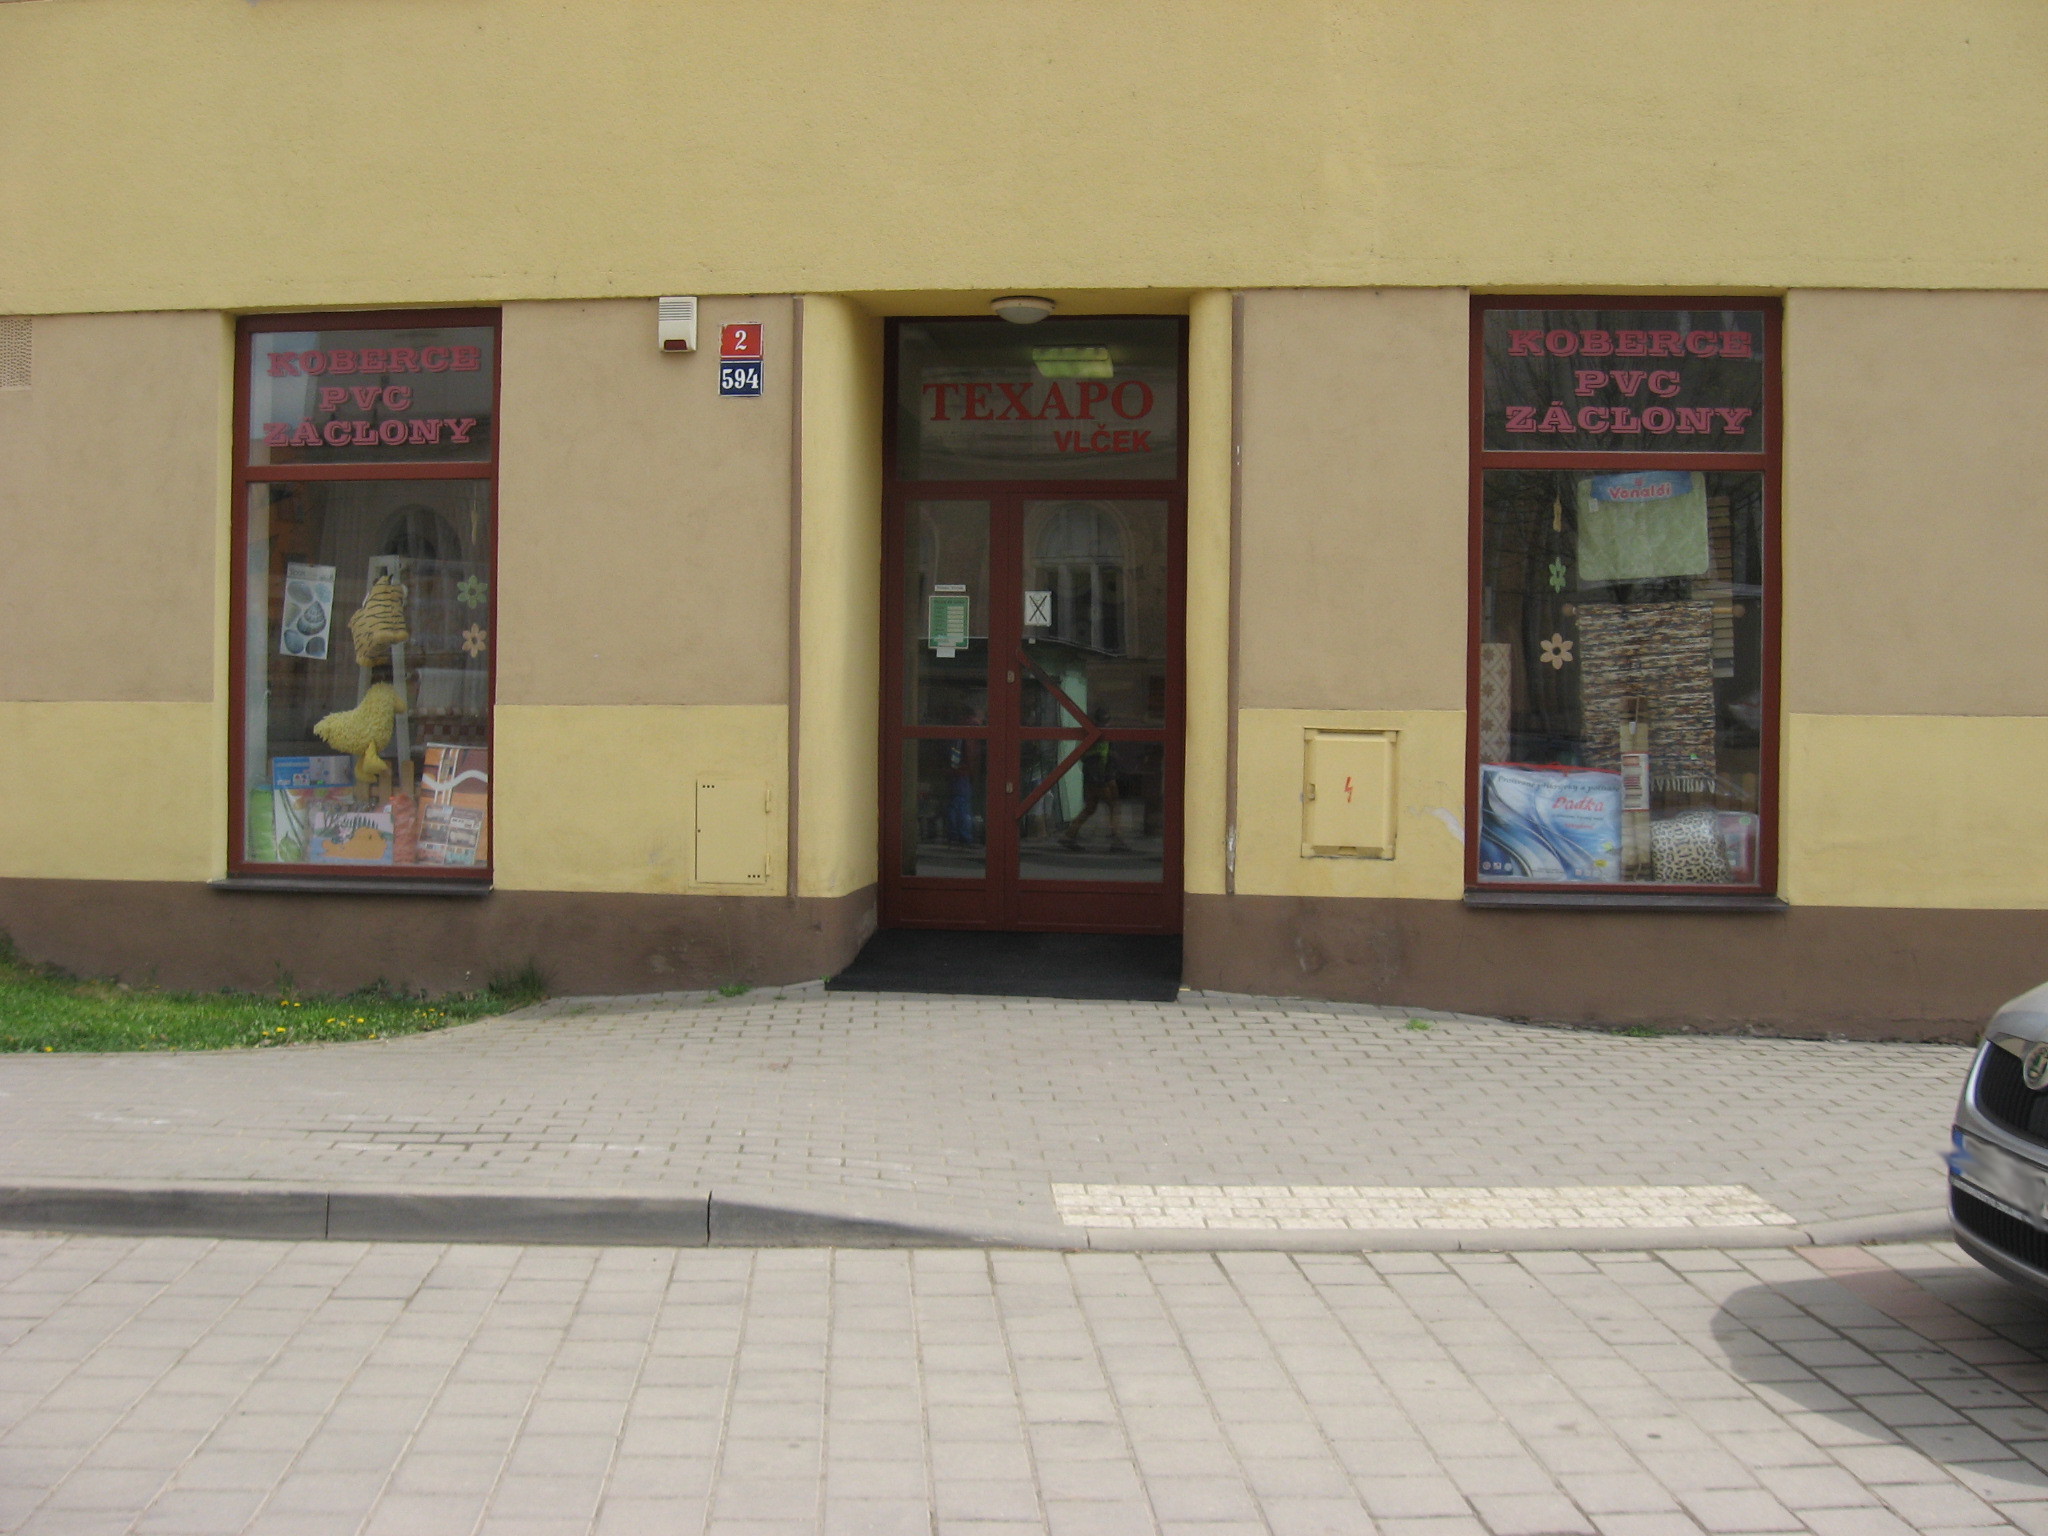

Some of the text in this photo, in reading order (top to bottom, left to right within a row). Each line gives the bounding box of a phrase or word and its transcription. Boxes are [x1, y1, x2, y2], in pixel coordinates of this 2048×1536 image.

[734, 330, 748, 351] 2
[1507, 330, 1752, 358] KOBERCE
[267, 345, 482, 377] KOBERCE
[721, 368, 759, 389] 594
[1574, 370, 1681, 398] PVC
[319, 385, 414, 412] PVC
[922, 380, 1154, 421] TEXAPO
[263, 416, 476, 447] ZÁCLONY
[1505, 401, 1752, 435] ZÁCLONY
[1053, 424, 1152, 453] VLČEK
